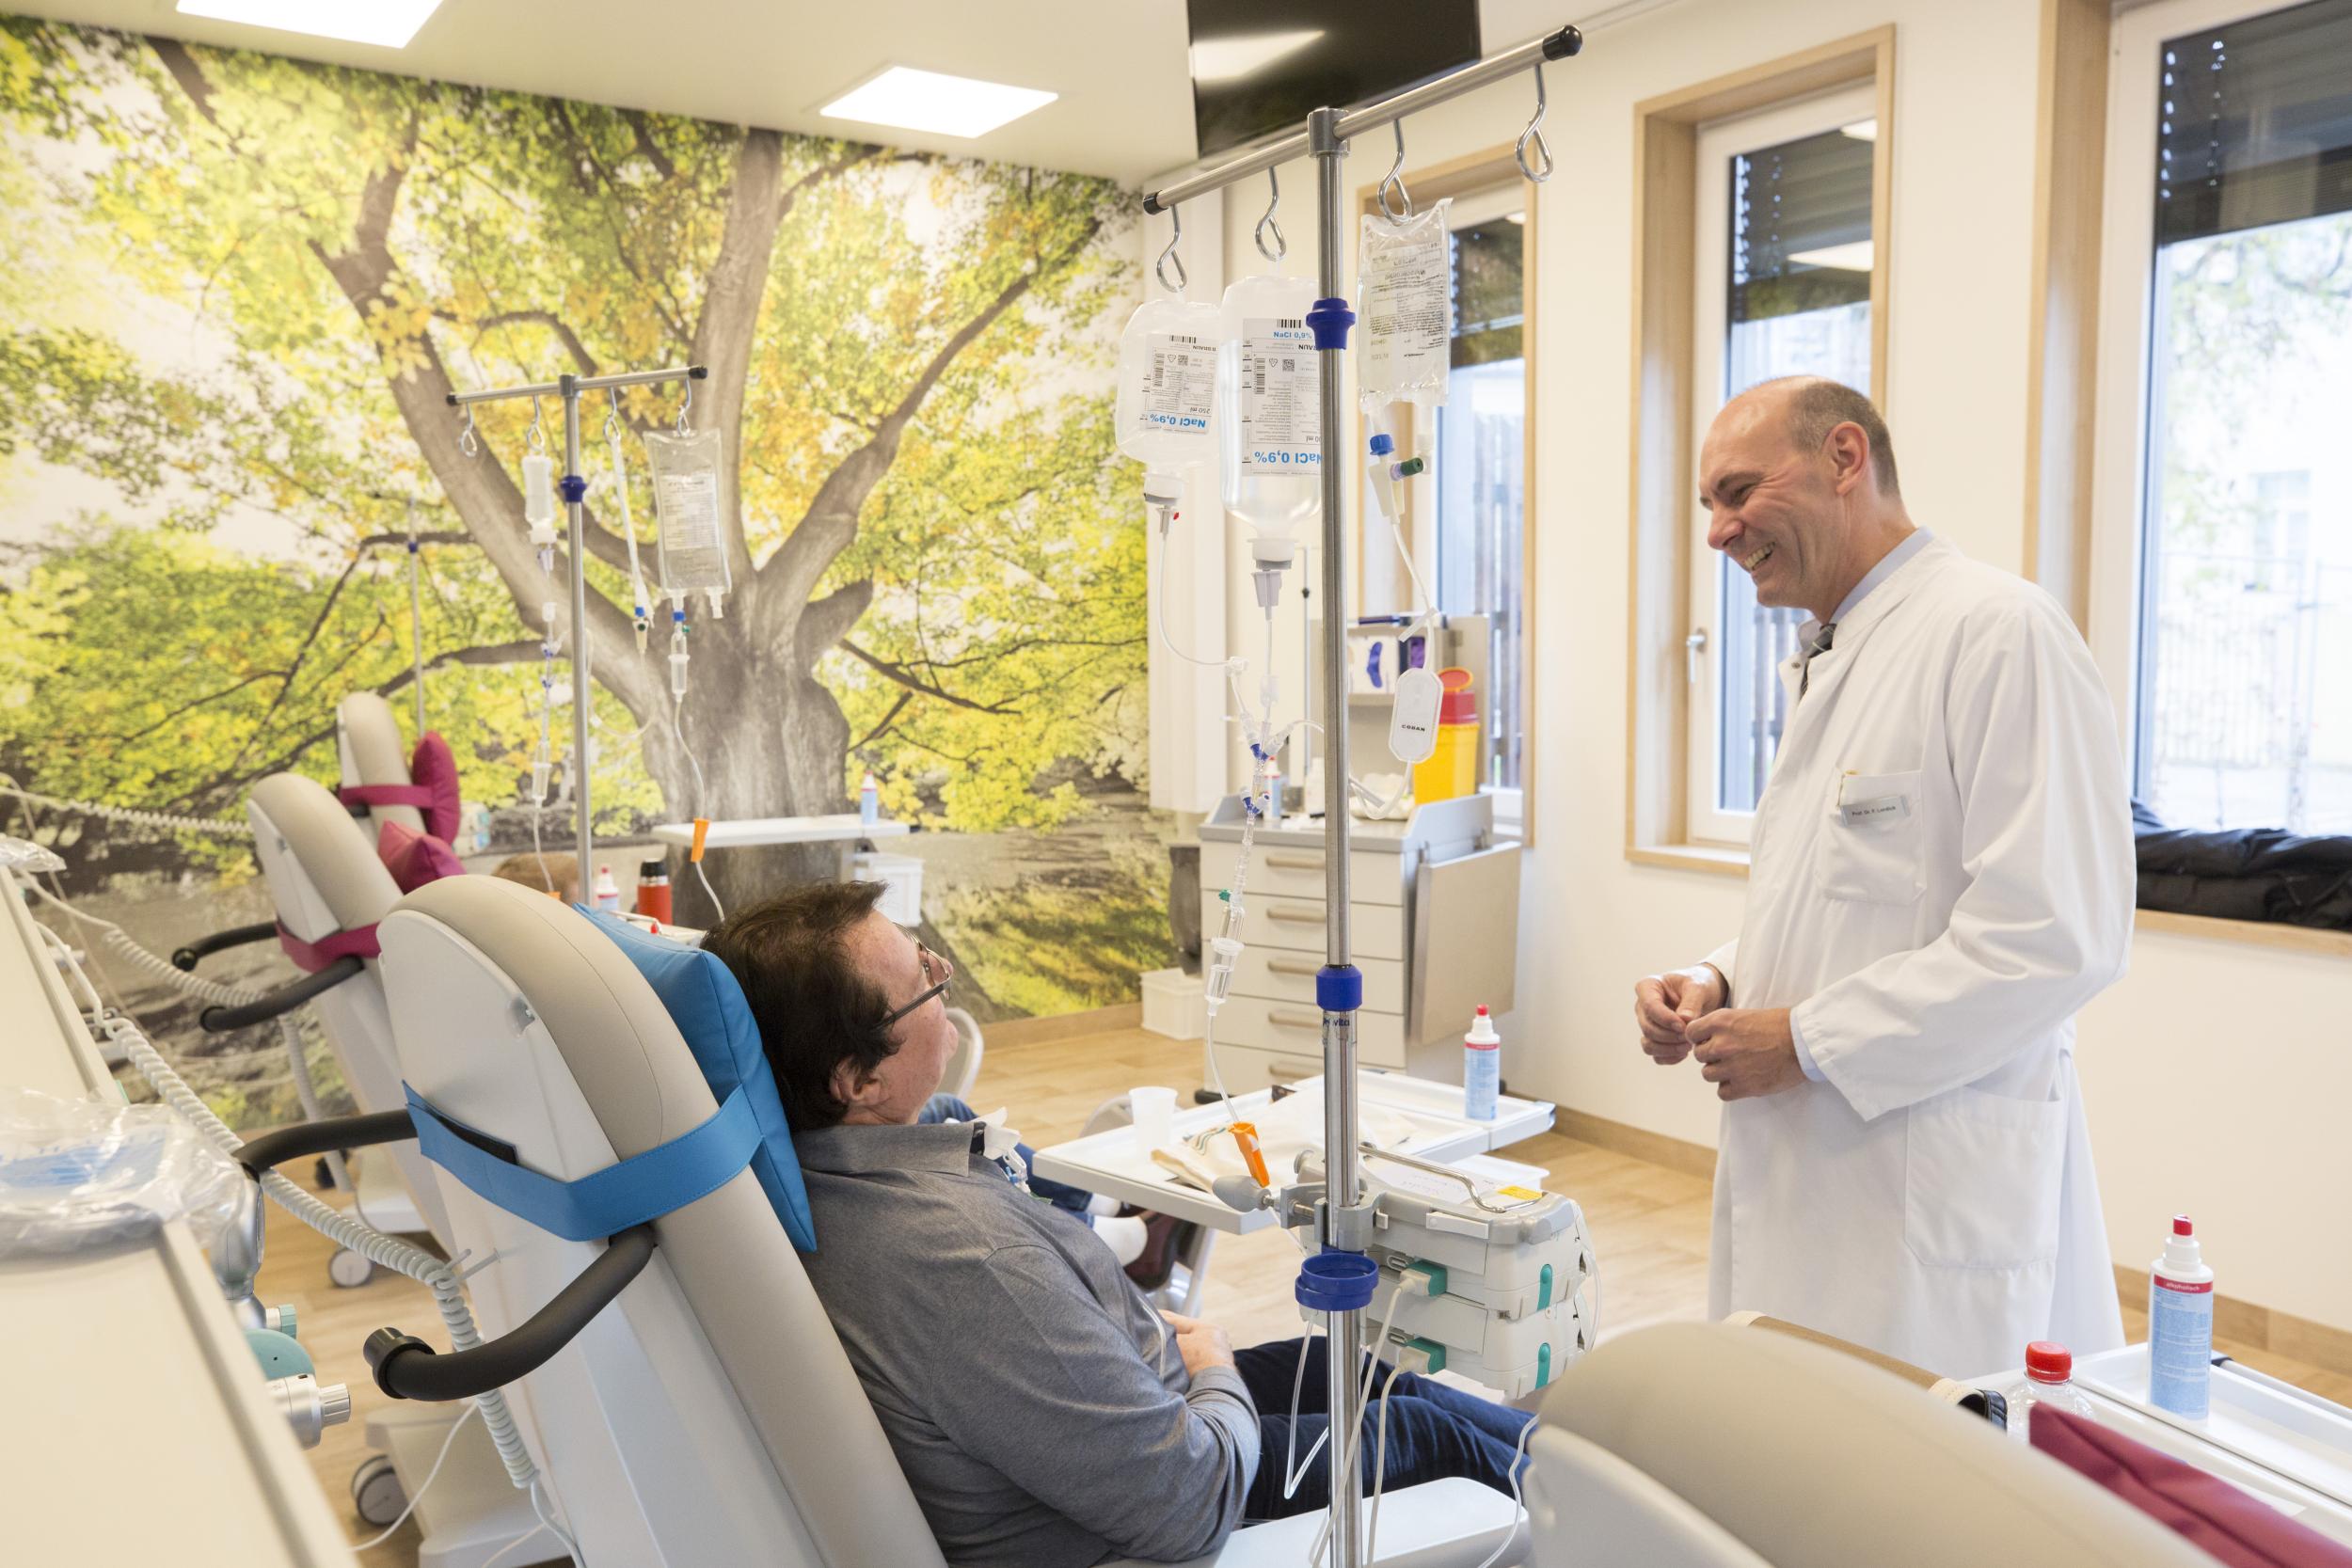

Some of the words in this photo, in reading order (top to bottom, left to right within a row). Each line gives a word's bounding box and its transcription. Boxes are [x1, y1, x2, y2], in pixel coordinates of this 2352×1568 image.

[1150, 413, 1176, 425] 0,9%
[1179, 418, 1206, 429] NaCl
[1254, 451, 1290, 464] 0,9%
[1295, 452, 1324, 465] NaCl
